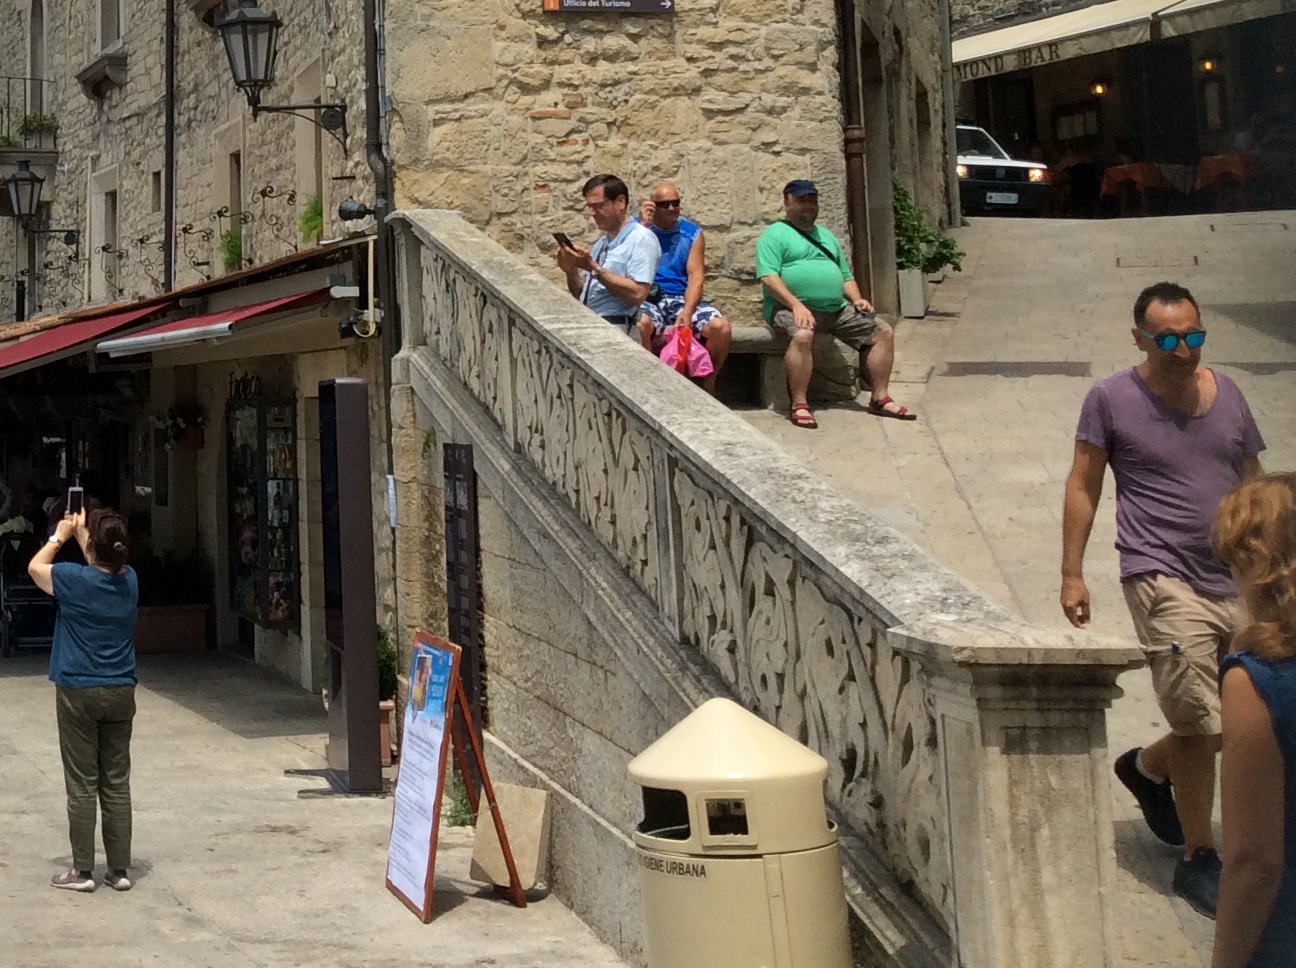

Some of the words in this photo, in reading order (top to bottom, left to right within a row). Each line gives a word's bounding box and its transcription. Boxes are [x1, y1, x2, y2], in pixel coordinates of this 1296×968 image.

[563, 0, 587, 7] Ufficio
[588, 0, 599, 7] del
[600, 0, 631, 8] Turismo
[1022, 44, 1061, 66] BAR
[666, 861, 706, 878] URBANA
